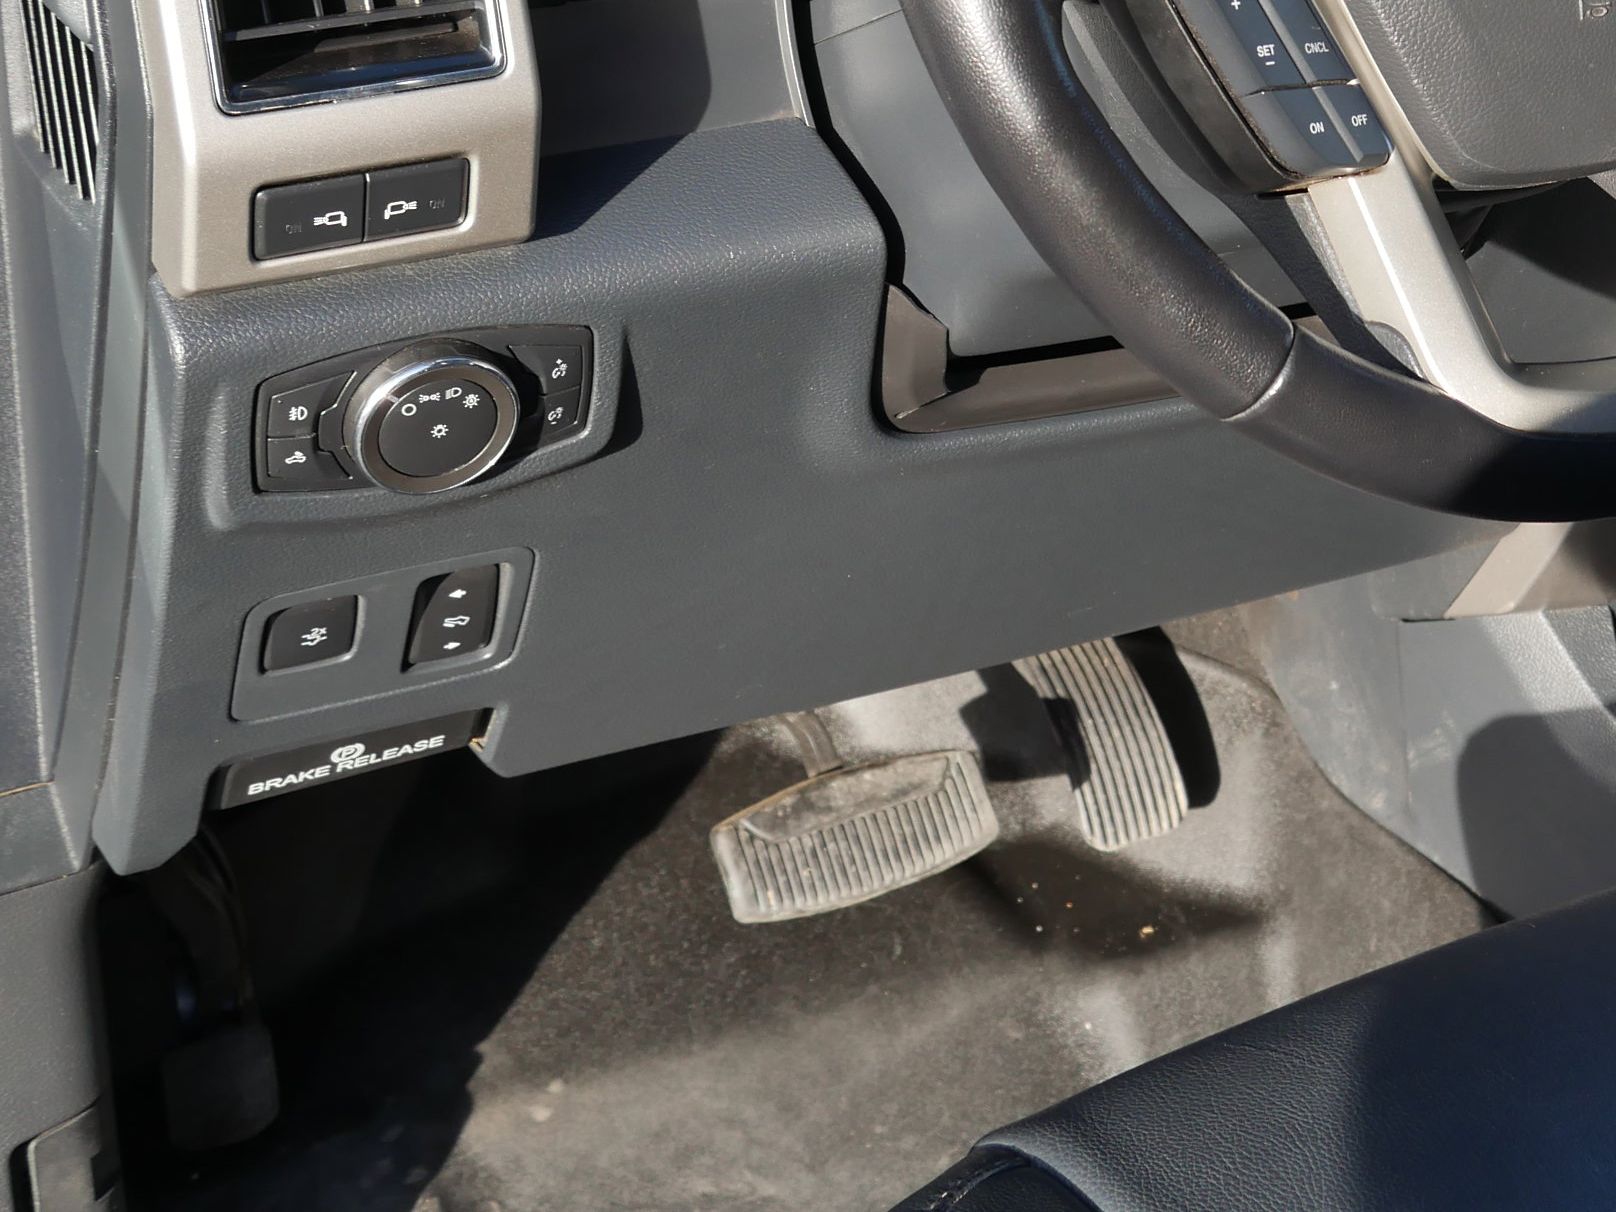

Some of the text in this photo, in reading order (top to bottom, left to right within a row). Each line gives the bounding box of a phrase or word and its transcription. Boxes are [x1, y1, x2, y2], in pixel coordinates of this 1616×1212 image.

[1256, 44, 1275, 58] SET
[1304, 41, 1329, 54] CNCL
[1351, 113, 1368, 127] OFF
[1309, 121, 1325, 134] ON
[247, 734, 446, 796] BRAKE RELEASE
